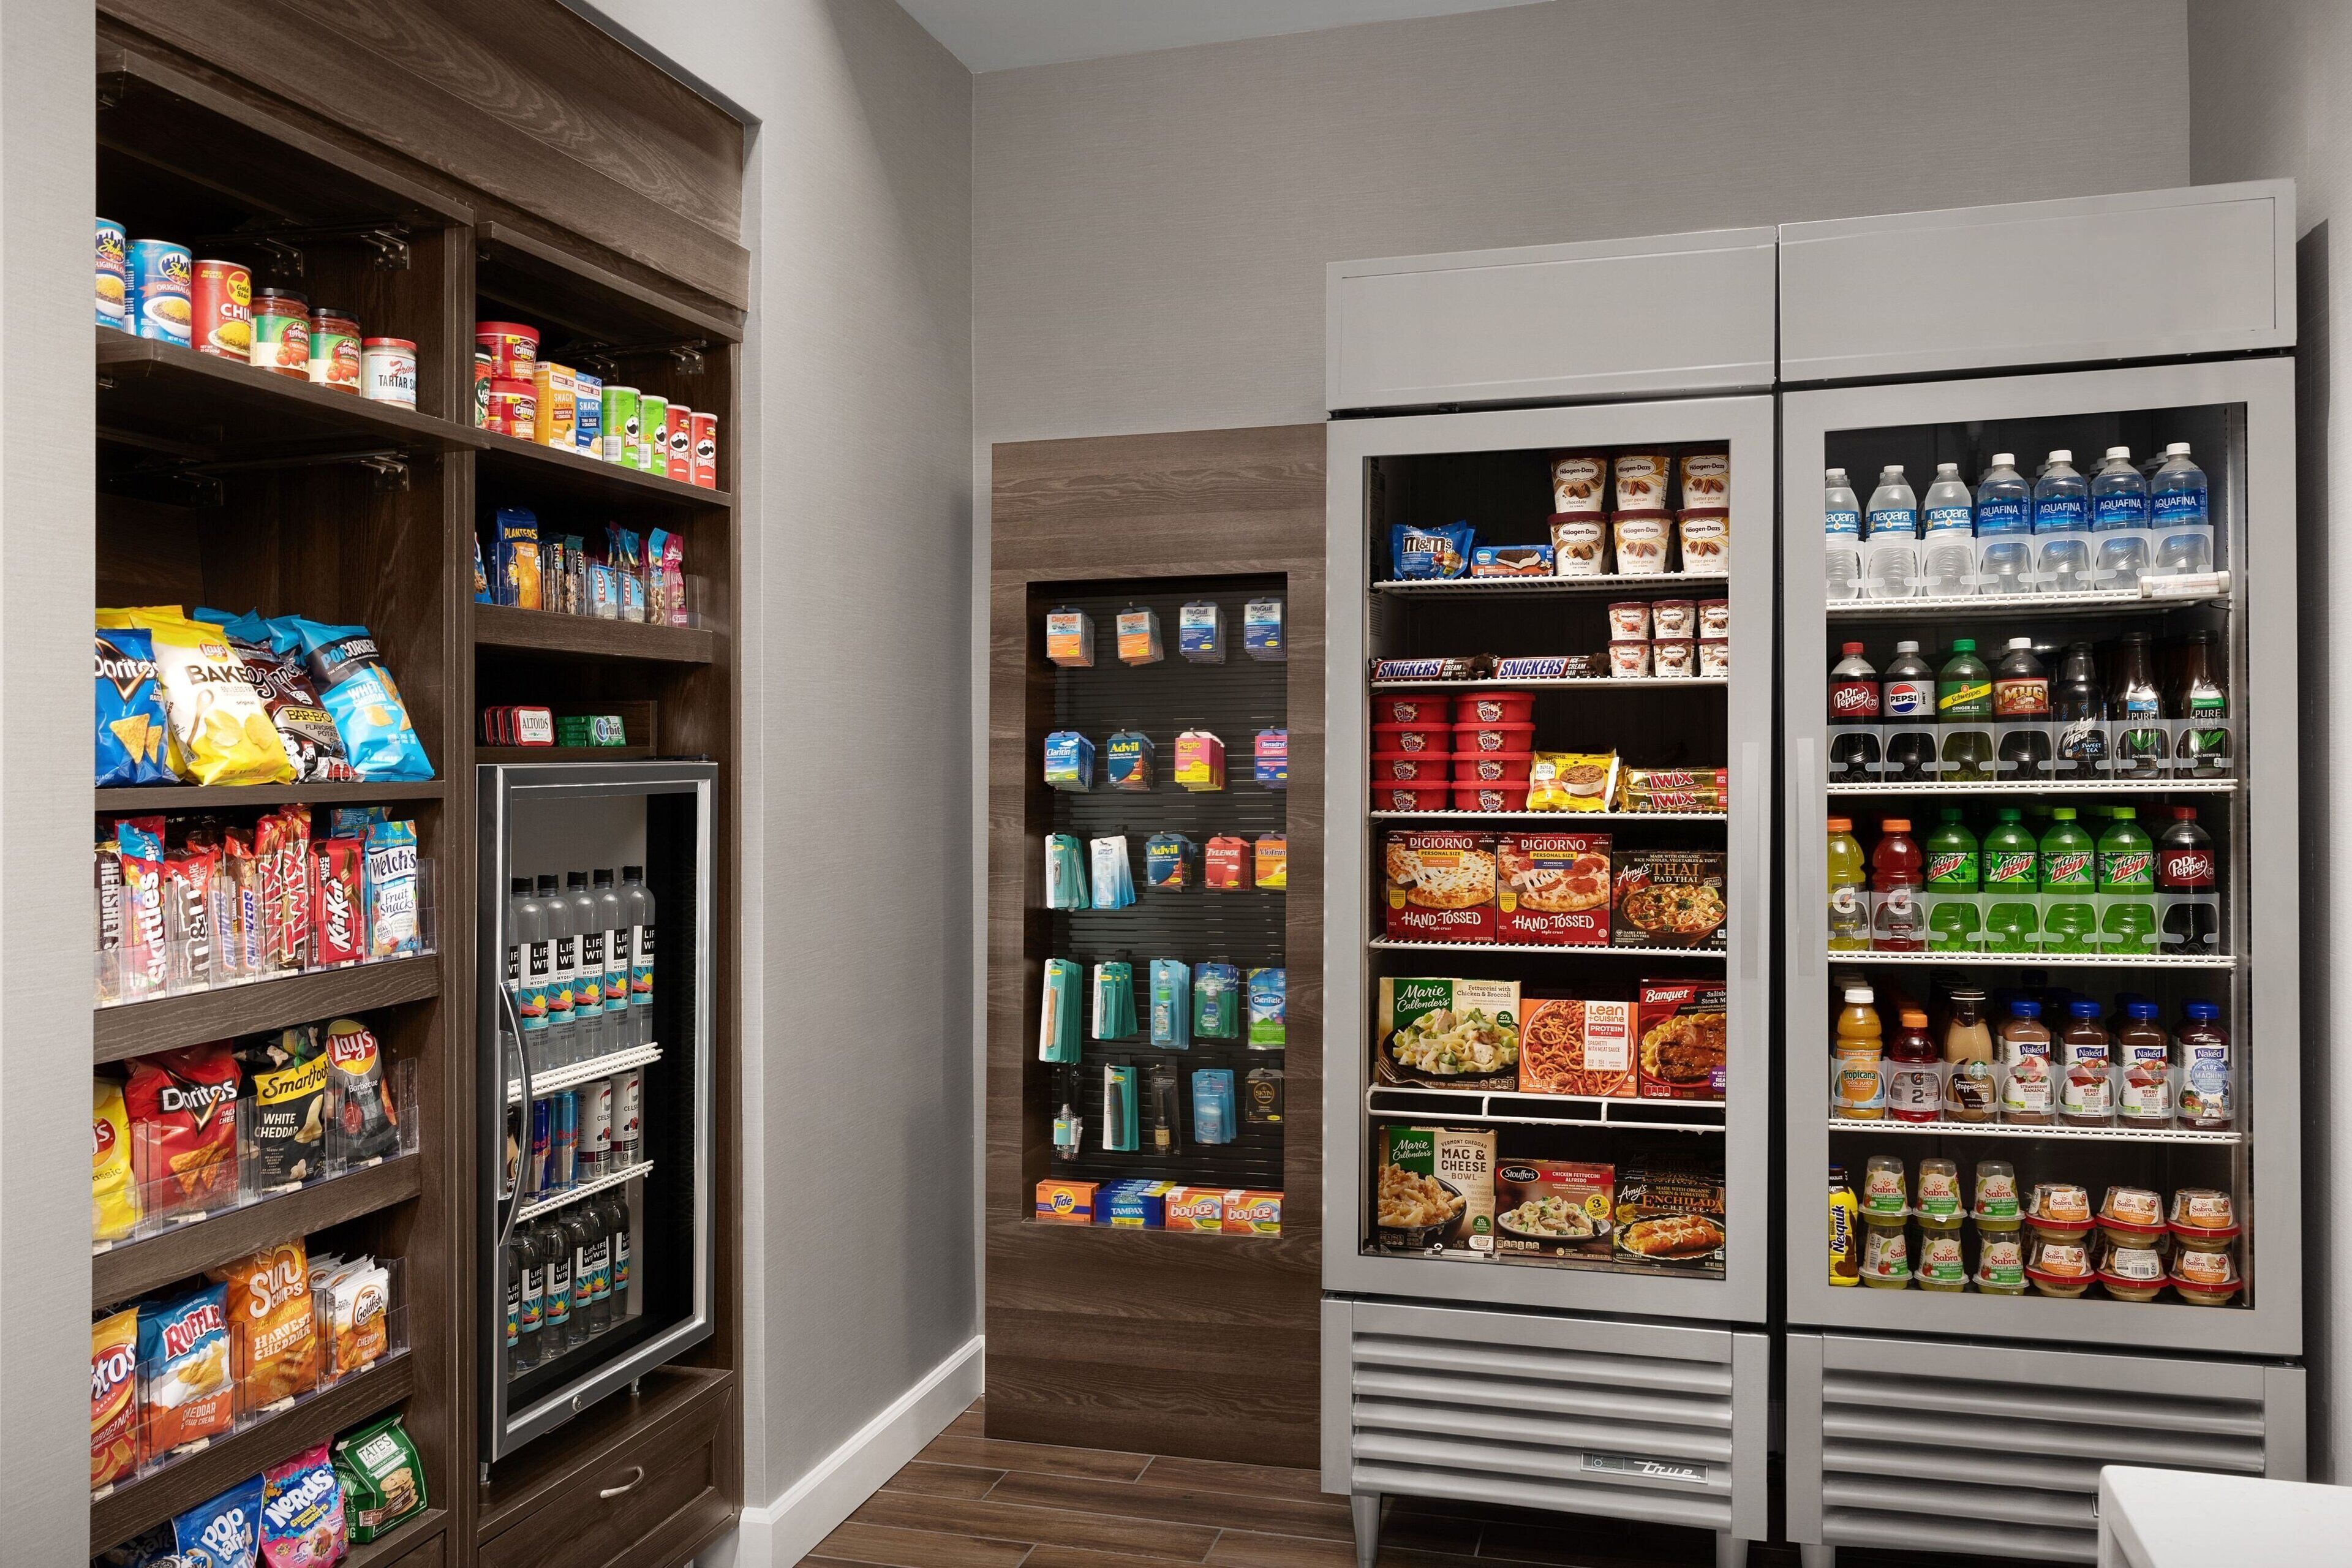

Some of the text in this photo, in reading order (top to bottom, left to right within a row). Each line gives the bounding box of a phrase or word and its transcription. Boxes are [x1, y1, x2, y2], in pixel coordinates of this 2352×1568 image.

[236, 284, 249, 293] Gold
[236, 291, 249, 300] Star
[514, 345, 535, 357] CHUNKY
[378, 374, 408, 389] TARTAR
[553, 393, 573, 402] SNACK
[514, 406, 535, 417] CHUNKY
[579, 402, 599, 410] SNACK
[1559, 467, 1594, 475] Häagen-Dazs
[2040, 502, 2082, 515] AQUAFINA
[2099, 498, 2143, 511] AQUAFINA
[2154, 496, 2198, 508] AQUAFINA
[1872, 510, 1910, 524] niagara
[1930, 508, 1968, 522] niagara
[1980, 504, 2019, 518] AQUAFINA
[504, 527, 538, 540] PLANTERS
[203, 643, 226, 658] Lay's
[1381, 660, 1440, 677] SNICKERS
[1501, 658, 1564, 676] SNICKERS
[347, 680, 383, 699] WHITE
[1844, 688, 1858, 698] Dr
[2003, 687, 2043, 703] MUG
[1837, 690, 1866, 709] Pepper
[1890, 695, 1917, 703] PEPSI
[1950, 690, 1982, 704] Schweppes
[286, 709, 333, 722] BAR-B-Q
[2131, 712, 2155, 721] PURE
[2195, 709, 2221, 718] PURE
[522, 717, 549, 729] ALTOIDS
[595, 718, 621, 742] Orbit
[1109, 742, 1139, 753] Advil
[1178, 741, 1202, 750] Pepto
[1046, 748, 1071, 757] Claritin
[1148, 845, 1178, 855] Advil
[1257, 847, 1286, 856] Motrin
[371, 850, 417, 879] Welch's
[1651, 863, 1699, 876] THAI
[2172, 858, 2205, 878] Pepper
[1616, 862, 1650, 887] Amy's
[282, 843, 309, 960] TWIX
[384, 889, 409, 905] Fruit
[1831, 888, 1856, 914] G
[380, 898, 414, 917] Snacks
[243, 890, 256, 968] SNICKERS
[1396, 984, 1446, 1001] Marie
[1645, 989, 1691, 1003] Banquet
[1396, 998, 1450, 1012] Callender's
[1589, 1005, 1624, 1016] Lean
[333, 1030, 375, 1062] Lay's
[1843, 1069, 1876, 1080] Tropicana
[348, 1079, 379, 1093] Barbecue
[161, 1079, 238, 1112] Doritos
[1912, 1089, 1924, 1104] 2
[263, 1112, 296, 1125] WHITE
[254, 1126, 299, 1138] CHEDDAR
[1392, 1139, 1430, 1152] Marie
[1464, 1140, 1488, 1149] CHEDDAR
[1441, 1148, 1486, 1160] MAC &
[1441, 1161, 1487, 1172] CHEESE
[1504, 1169, 1536, 1180] Stouffer's
[1872, 1183, 1897, 1193] Sabra
[1923, 1186, 1948, 1196] Sabra
[1985, 1188, 2011, 1198] Sabra
[1053, 1194, 1073, 1209] Tide
[1592, 1199, 1602, 1208] 3
[1640, 1194, 1725, 1214] ENCHILADA
[1169, 1202, 1213, 1219] bounce
[1227, 1205, 1272, 1222] bounce
[1830, 1204, 1845, 1254] Nesquik
[592, 1240, 606, 1251] LIFE
[592, 1248, 607, 1259] WTR
[556, 1263, 568, 1273] LIFE
[556, 1272, 568, 1281] WTR
[249, 1259, 303, 1319] Sun
[270, 1281, 304, 1309] CHIPS
[285, 1302, 303, 1319] GRAIN
[356, 1293, 383, 1324] Goldfish
[254, 1312, 312, 1351] HARVEST
[254, 1325, 311, 1362] CHEDDAR
[183, 1402, 216, 1422] CHEDDAR
[197, 1415, 215, 1427] CREAM
[358, 1436, 392, 1461] TATE'S
[368, 1446, 393, 1465] BAKE SHOP
